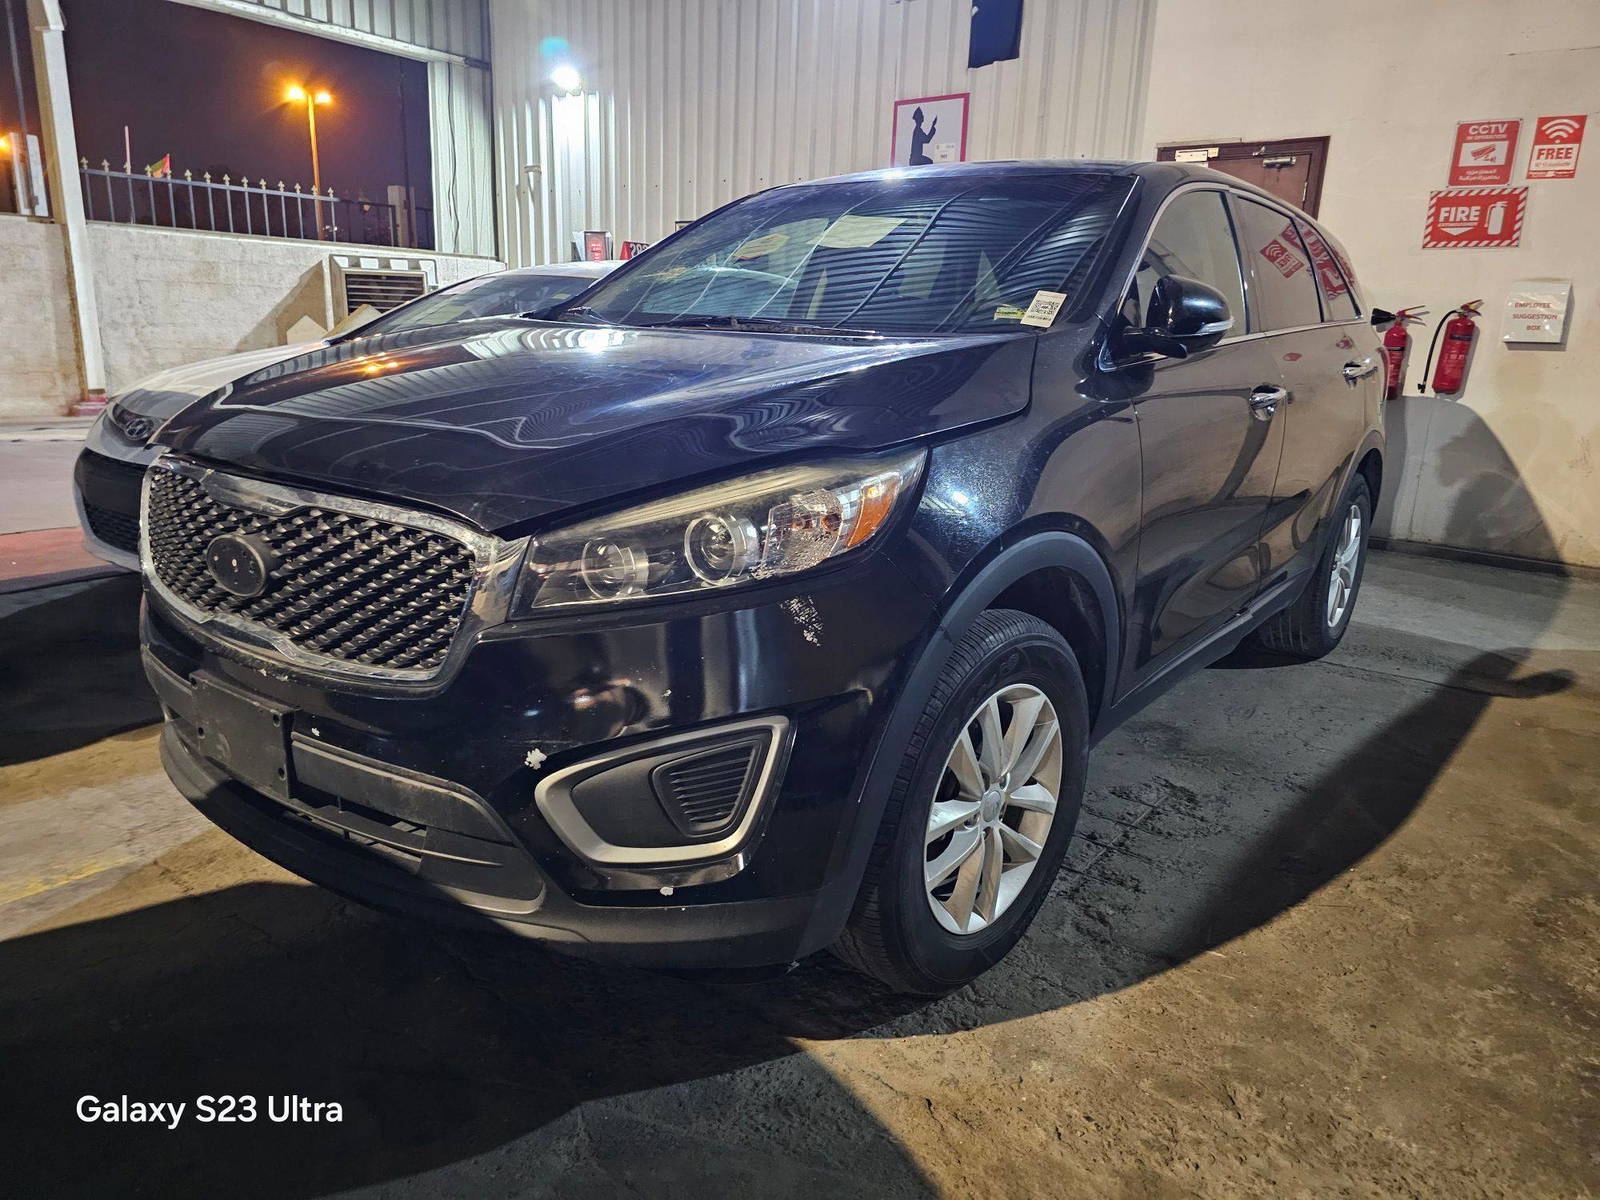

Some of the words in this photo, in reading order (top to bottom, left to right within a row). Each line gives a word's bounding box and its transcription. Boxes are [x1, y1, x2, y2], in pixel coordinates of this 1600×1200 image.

[1468, 124, 1508, 135] CCTV
[1536, 147, 1573, 160] FREE
[1439, 206, 1481, 222] FIRE
